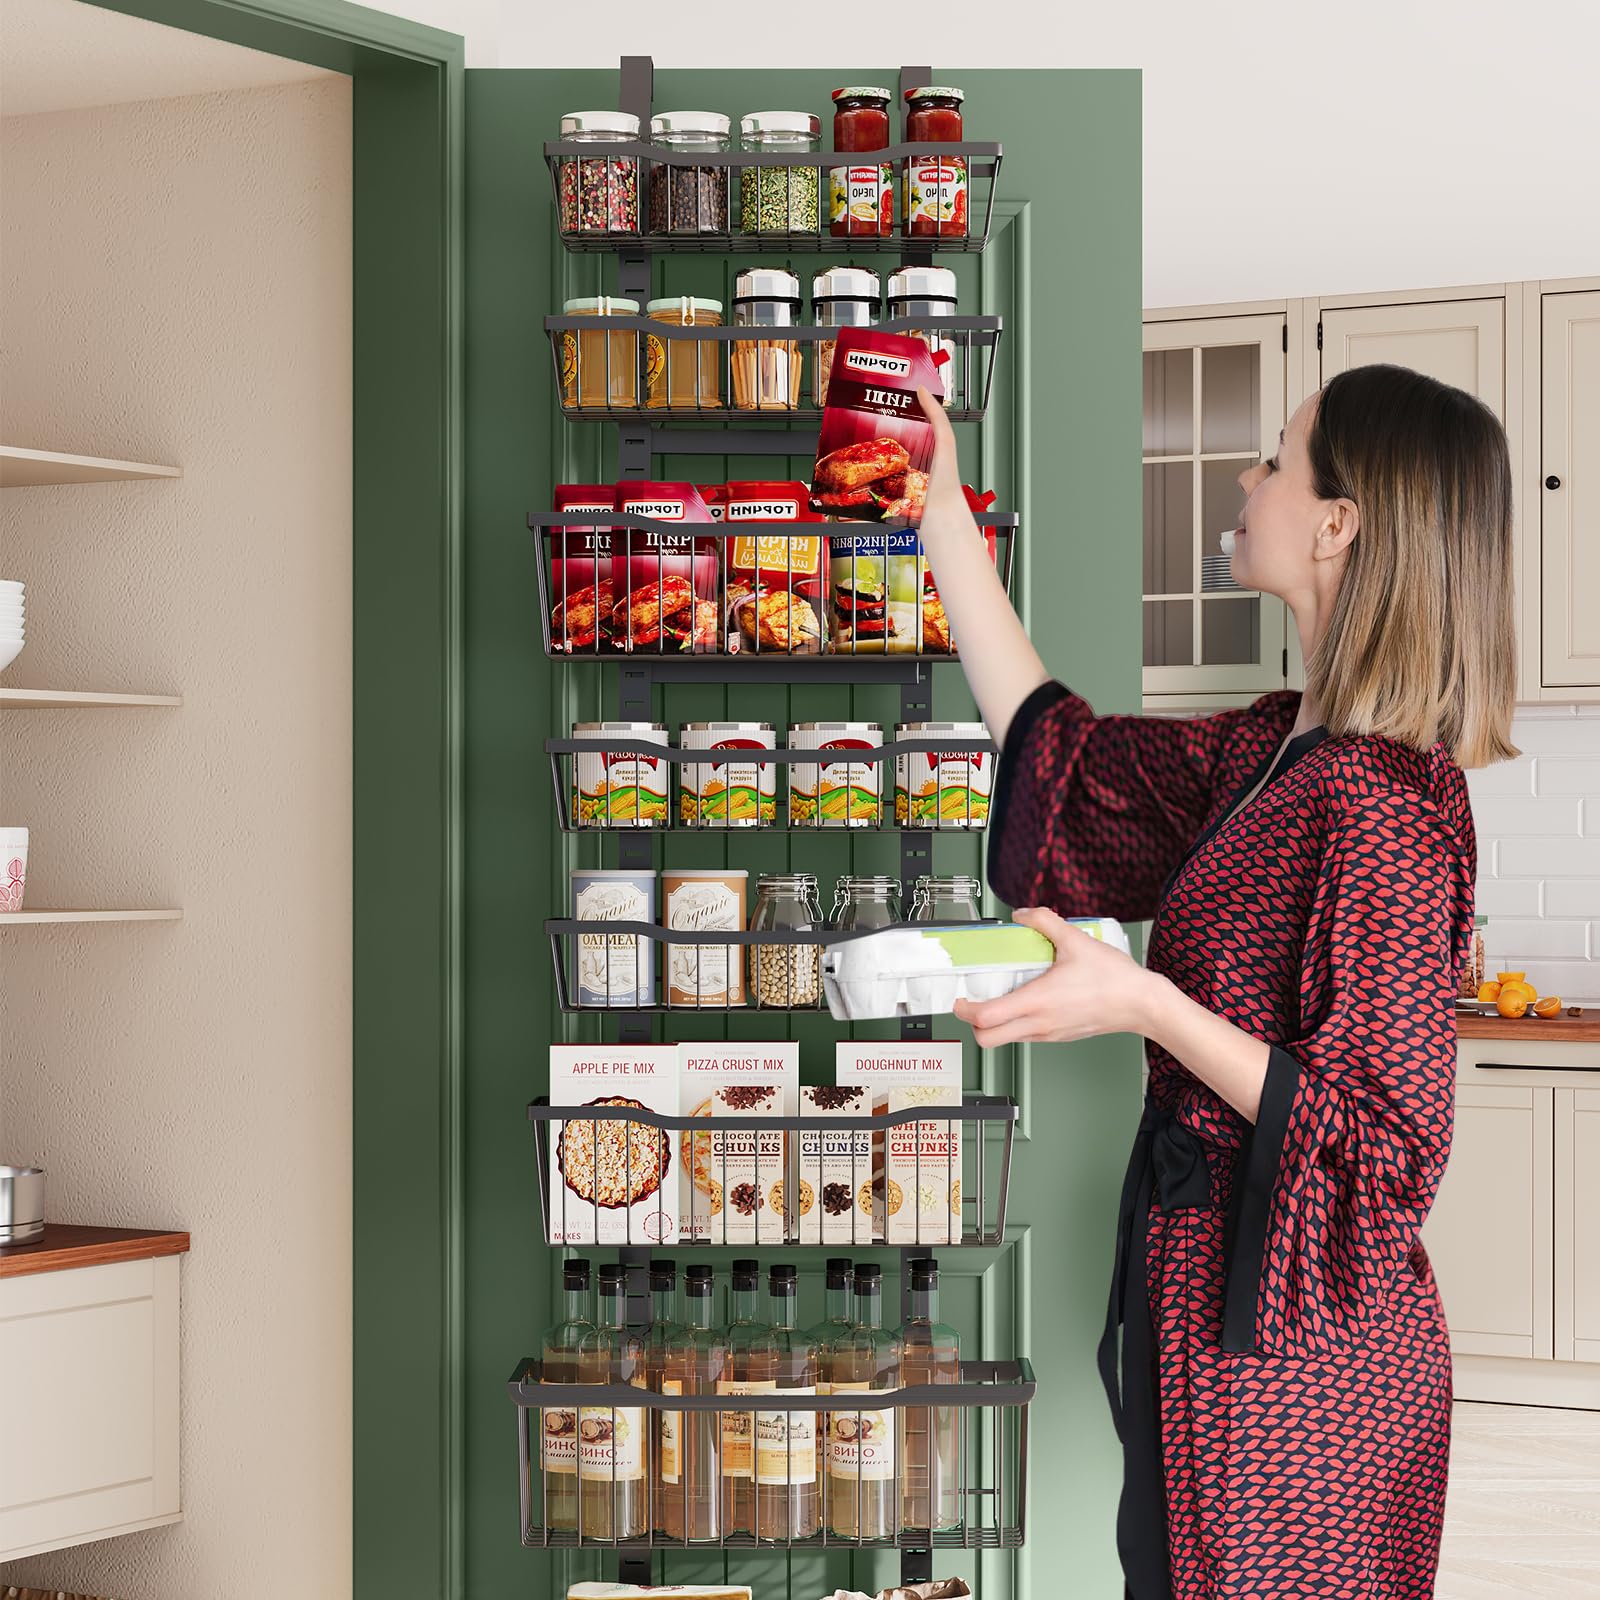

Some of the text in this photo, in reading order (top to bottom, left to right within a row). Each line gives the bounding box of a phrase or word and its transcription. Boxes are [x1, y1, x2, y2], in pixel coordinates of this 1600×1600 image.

[671, 895, 729, 930] Organic
[582, 934, 641, 946] OATMEA
[572, 1062, 655, 1074] APPLE PIE MIX
[687, 1059, 784, 1070] PIZZA CRUST MIX
[856, 1059, 943, 1070] DOUGHNUT MIX
[713, 1142, 780, 1153] CHUNKS
[802, 1142, 869, 1153] CHUNKS
[891, 1142, 958, 1153] CHUNKS
[833, 1445, 875, 1457] ВИНО
